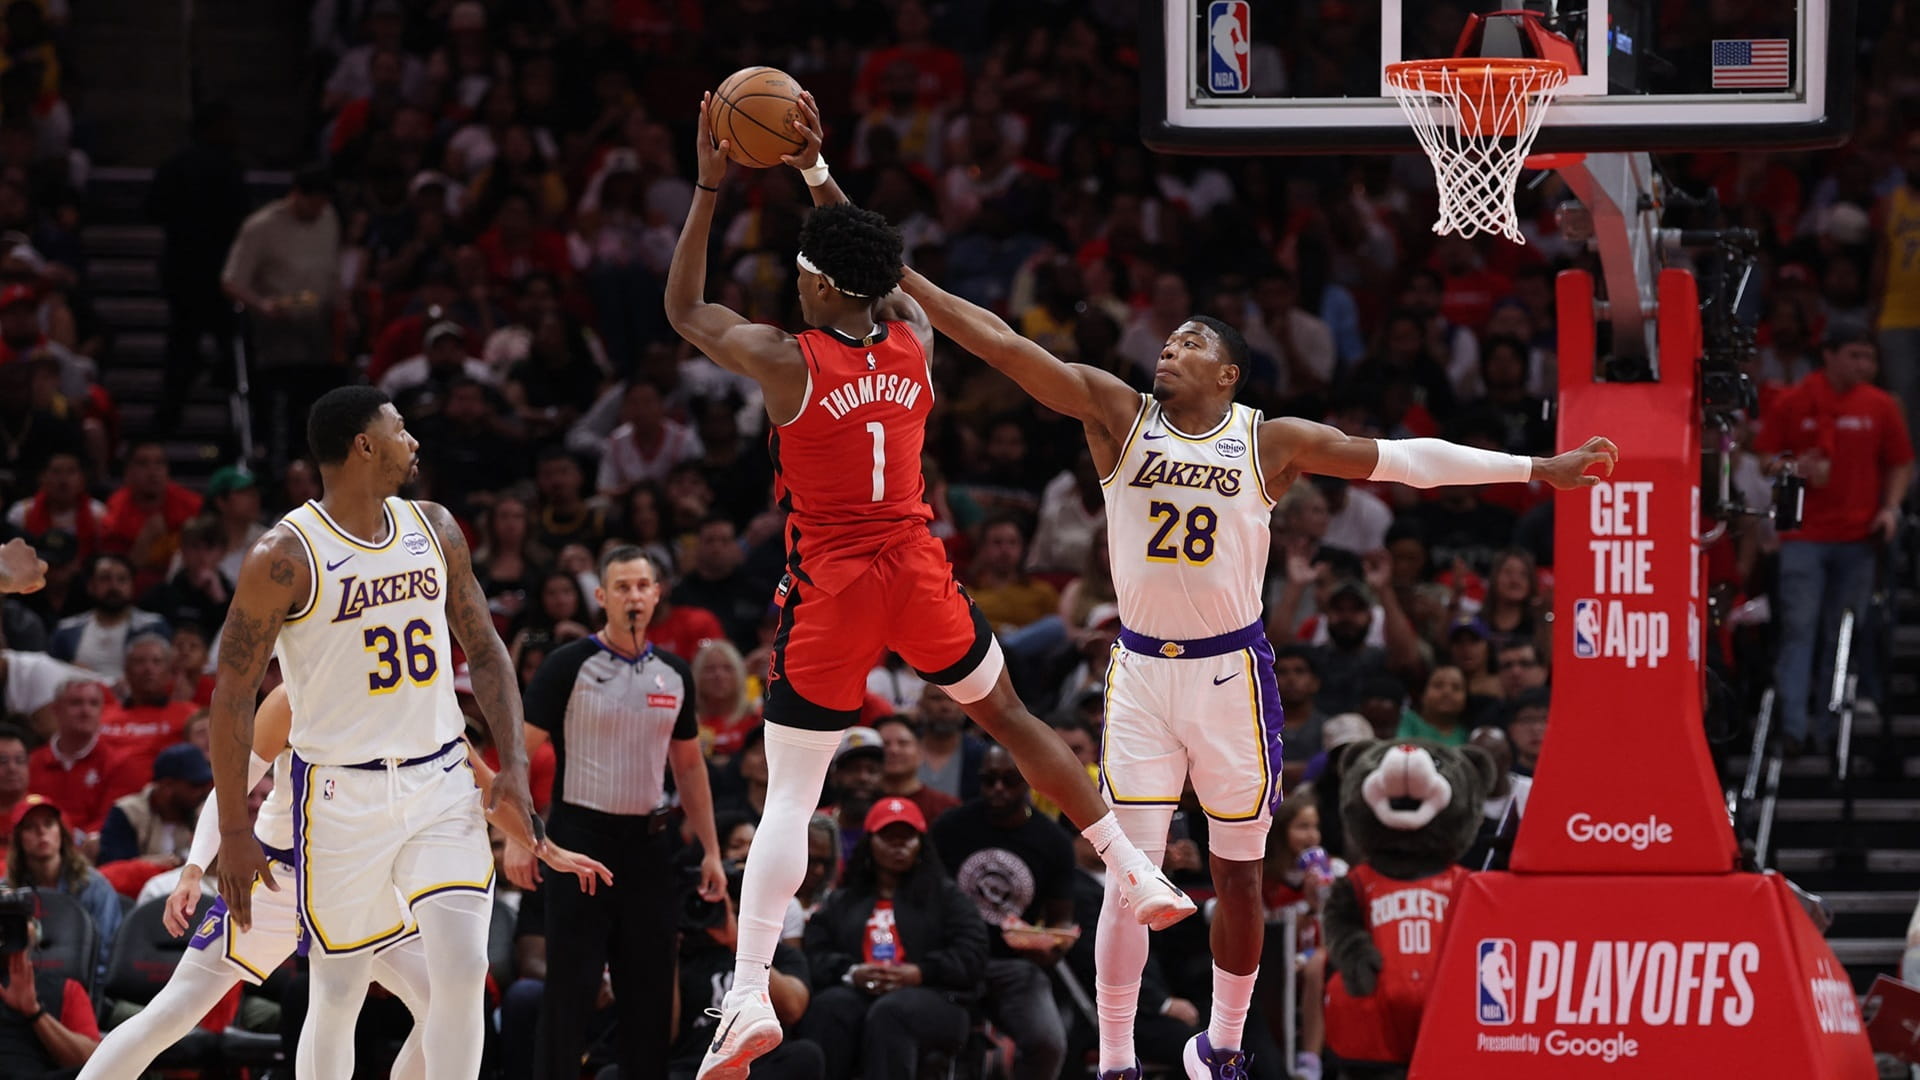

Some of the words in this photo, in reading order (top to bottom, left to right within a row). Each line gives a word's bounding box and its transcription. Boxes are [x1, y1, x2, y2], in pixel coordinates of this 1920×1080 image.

[1214, 72, 1235, 88] NBA
[819, 374, 922, 420] THOMPSON
[866, 421, 886, 502] 1
[1128, 450, 1243, 497] LAKERS
[1218, 442, 1244, 453] bibigo
[1145, 500, 1218, 567] 28
[1590, 481, 1654, 536] GET
[1589, 540, 1655, 594] THE
[330, 566, 441, 624] LAKERS
[362, 617, 440, 697] 36
[1603, 600, 1670, 668] App
[1566, 812, 1673, 851] Google
[1398, 919, 1431, 954] 00
[1521, 940, 1760, 1027] PLAYOFFS
[1476, 1032, 1527, 1053] Presented
[1527, 1032, 1541, 1055] by
[1545, 1029, 1639, 1063] Google
